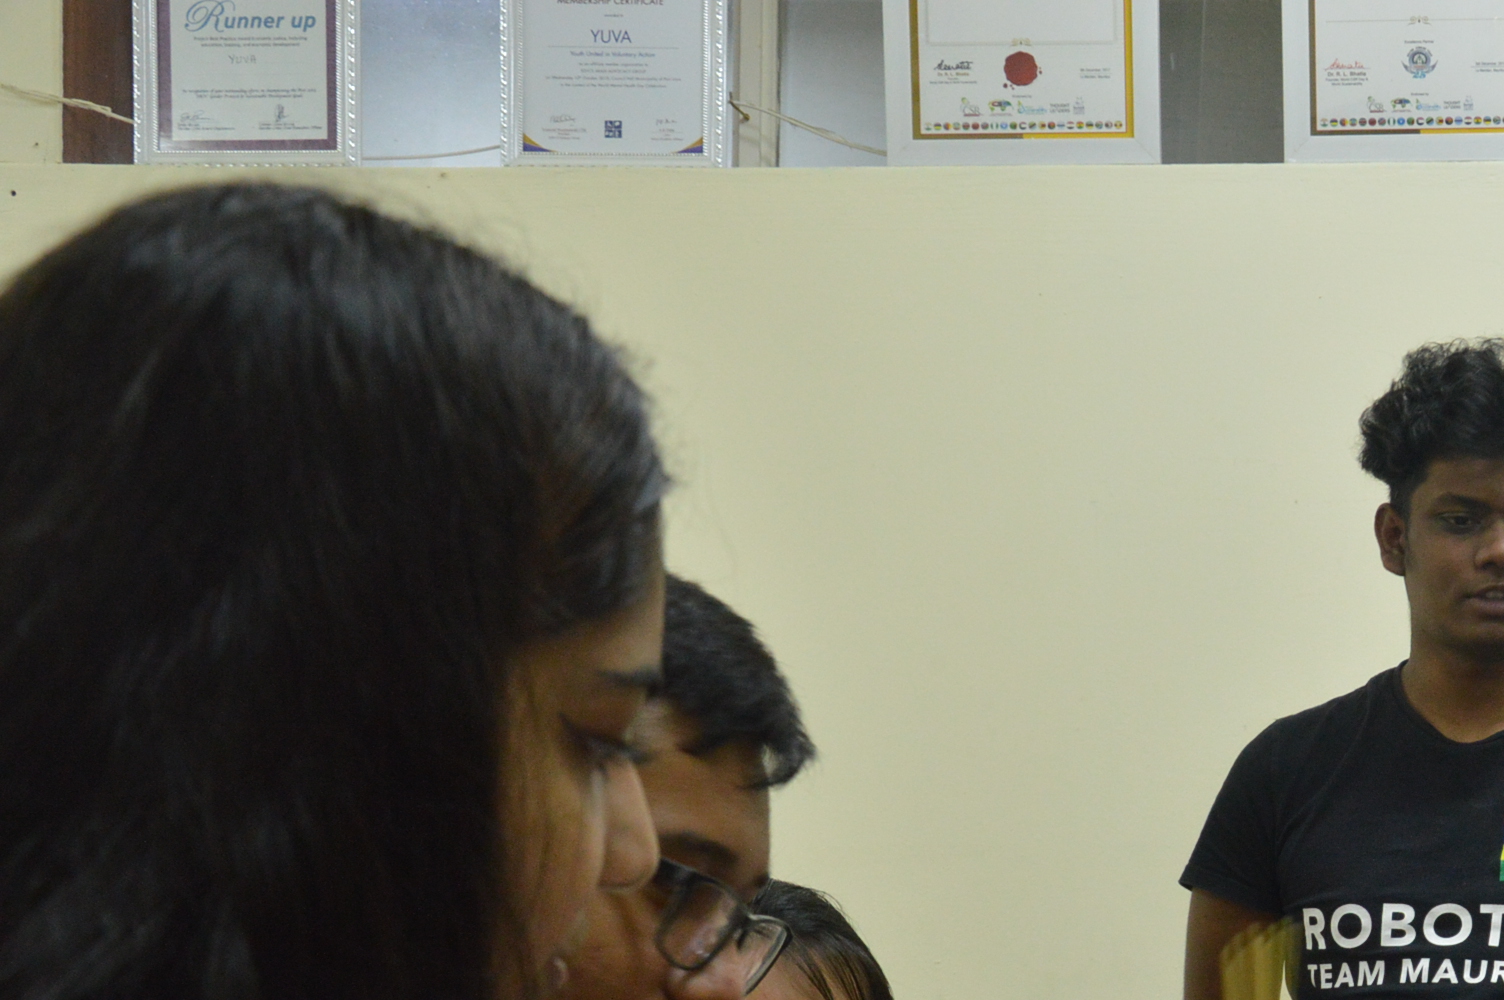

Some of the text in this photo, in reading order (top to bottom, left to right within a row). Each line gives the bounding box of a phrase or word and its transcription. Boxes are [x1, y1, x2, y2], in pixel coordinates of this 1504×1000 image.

[184, 0, 316, 32] Runner up
[590, 29, 632, 44] YUVA
[228, 54, 257, 64] YUVA
[1307, 960, 1386, 990] TEAM
